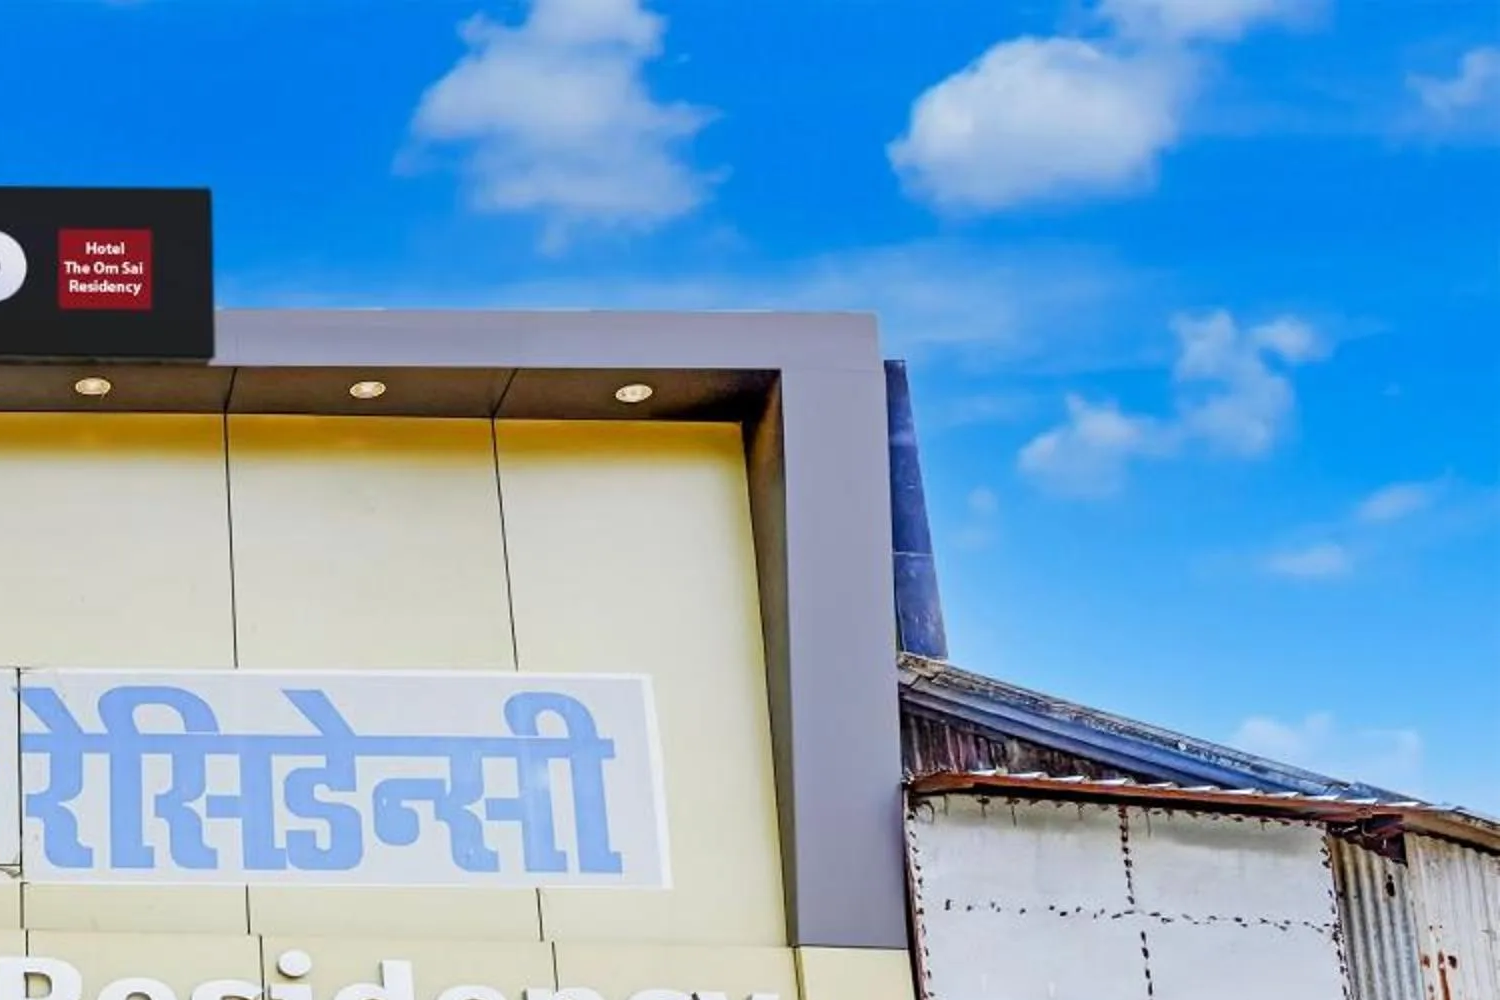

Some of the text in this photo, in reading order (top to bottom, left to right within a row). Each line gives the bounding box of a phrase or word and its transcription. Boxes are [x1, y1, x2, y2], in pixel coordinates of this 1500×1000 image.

[85, 241, 125, 255] Hotel
[64, 260, 144, 275] The Om Sai
[68, 279, 142, 297] Residency
[13, 685, 622, 874] रेसिडेन्सी
